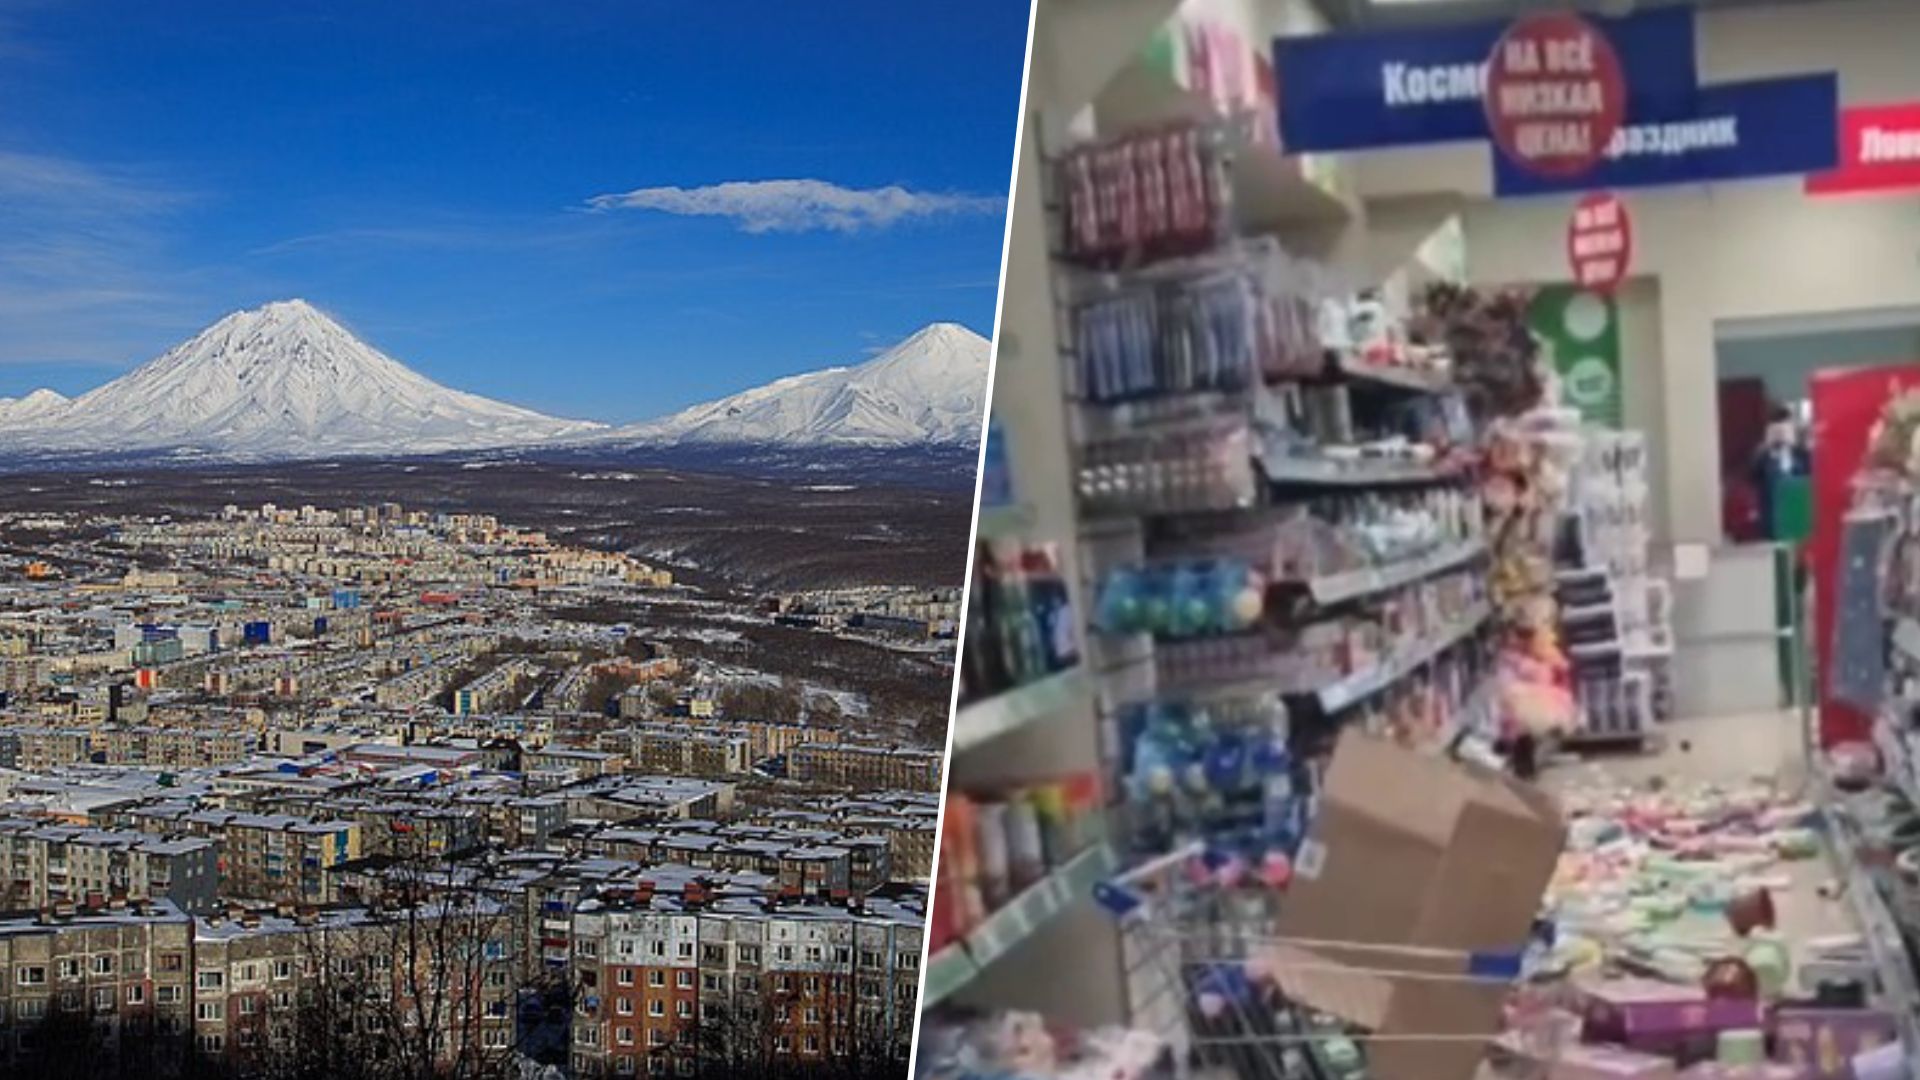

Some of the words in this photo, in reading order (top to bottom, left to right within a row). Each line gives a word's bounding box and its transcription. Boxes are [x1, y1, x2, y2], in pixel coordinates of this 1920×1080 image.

[1504, 39, 1540, 73] НА
[1545, 33, 1594, 73] ВСЁ
[1602, 115, 1738, 160] раздник
